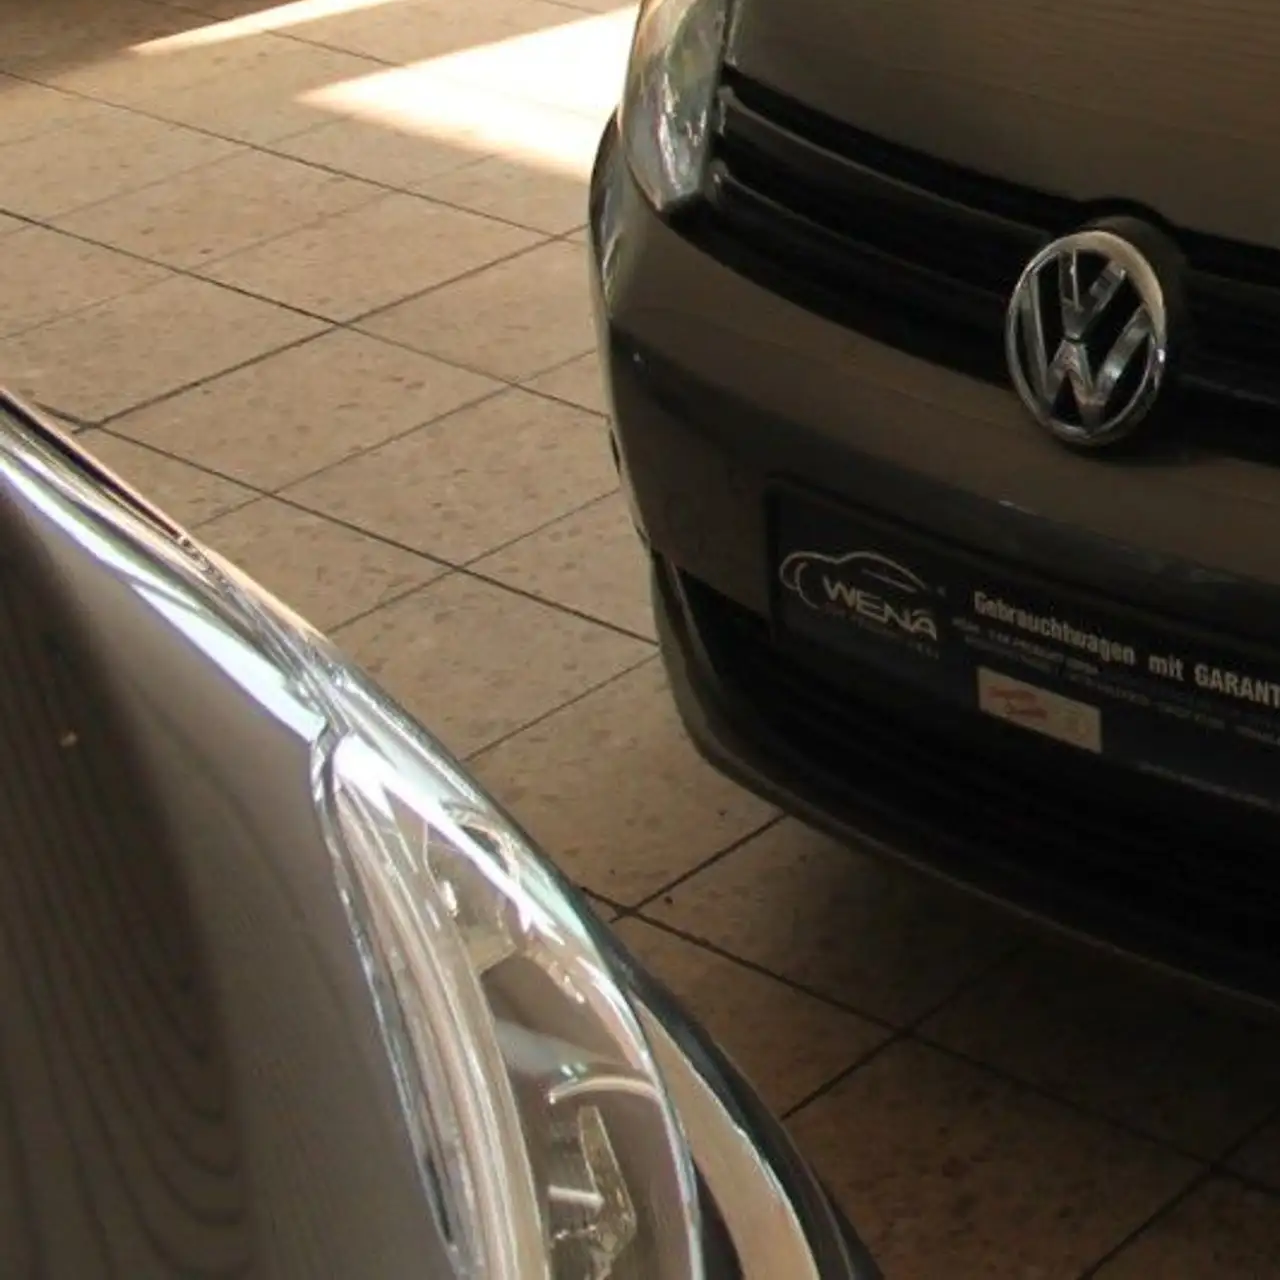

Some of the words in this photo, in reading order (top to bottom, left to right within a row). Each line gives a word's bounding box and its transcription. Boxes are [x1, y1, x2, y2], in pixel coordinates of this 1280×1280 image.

[1008, 235, 1162, 442] VW
[973, 590, 1137, 666] Gebrauchtwagen
[1148, 652, 1184, 682] mit
